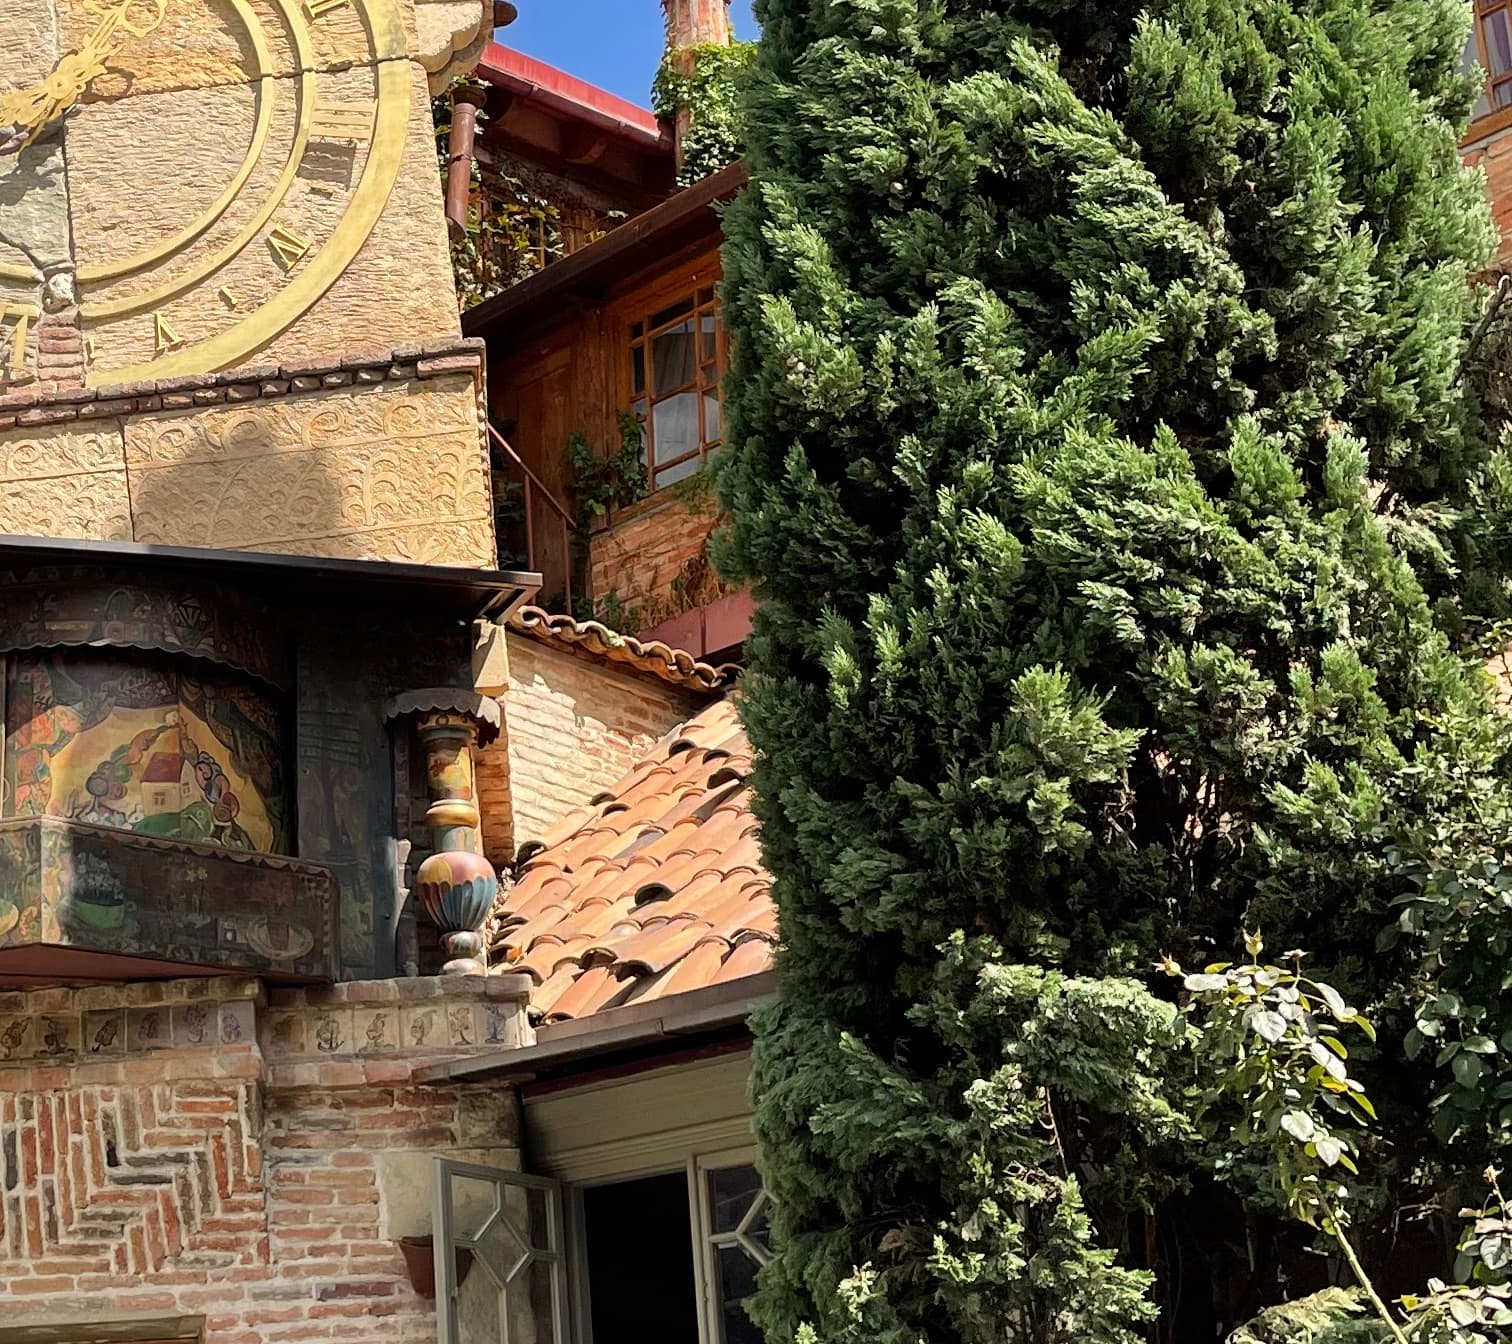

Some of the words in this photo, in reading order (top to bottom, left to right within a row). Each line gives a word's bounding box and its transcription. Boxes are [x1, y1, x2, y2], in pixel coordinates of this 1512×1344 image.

[308, 98, 378, 141] III
[267, 222, 314, 271] IV
[154, 312, 185, 350] V
